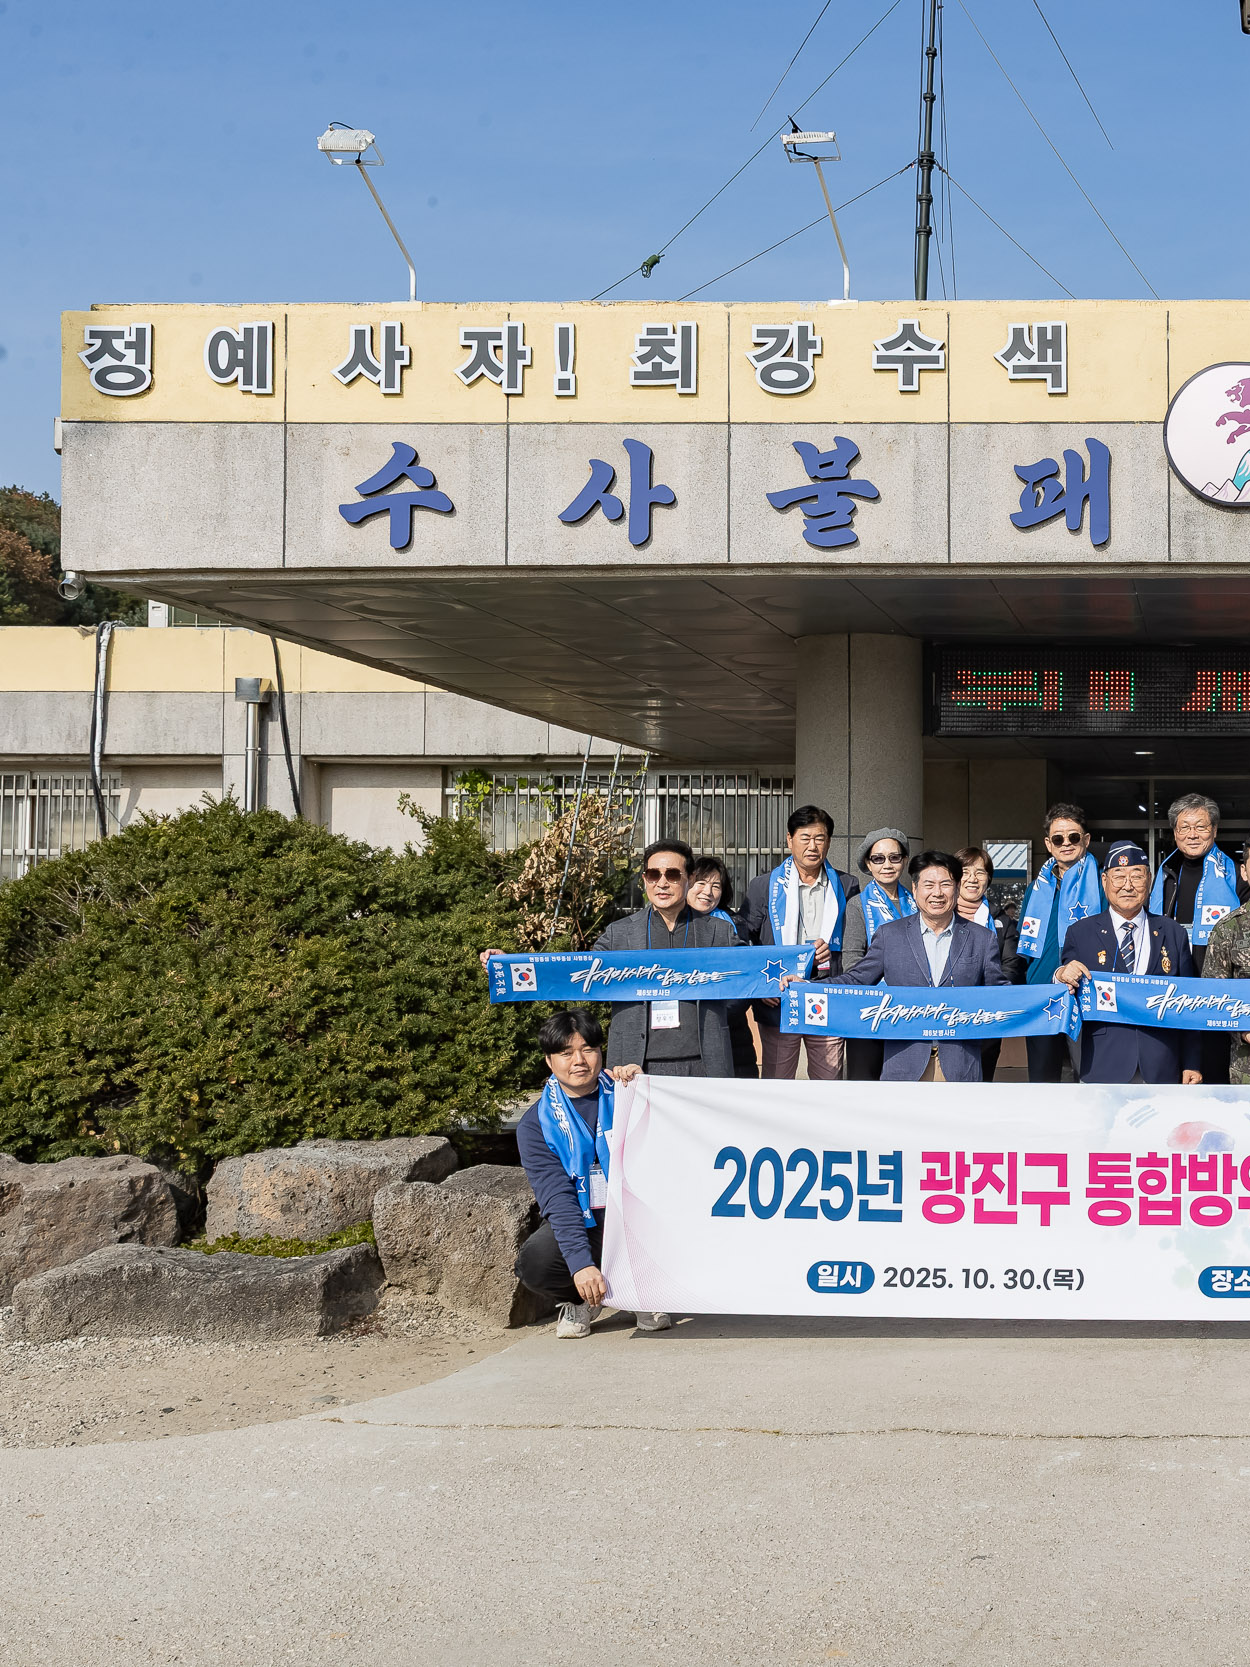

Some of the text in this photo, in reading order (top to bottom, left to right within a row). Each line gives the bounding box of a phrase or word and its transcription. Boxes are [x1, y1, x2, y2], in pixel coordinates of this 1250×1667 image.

[711, 1146, 903, 1222] 2025년
[920, 1152, 1070, 1227] 광진구
[816, 1265, 1085, 1292] 일시 2025. 10. 30.(목)
